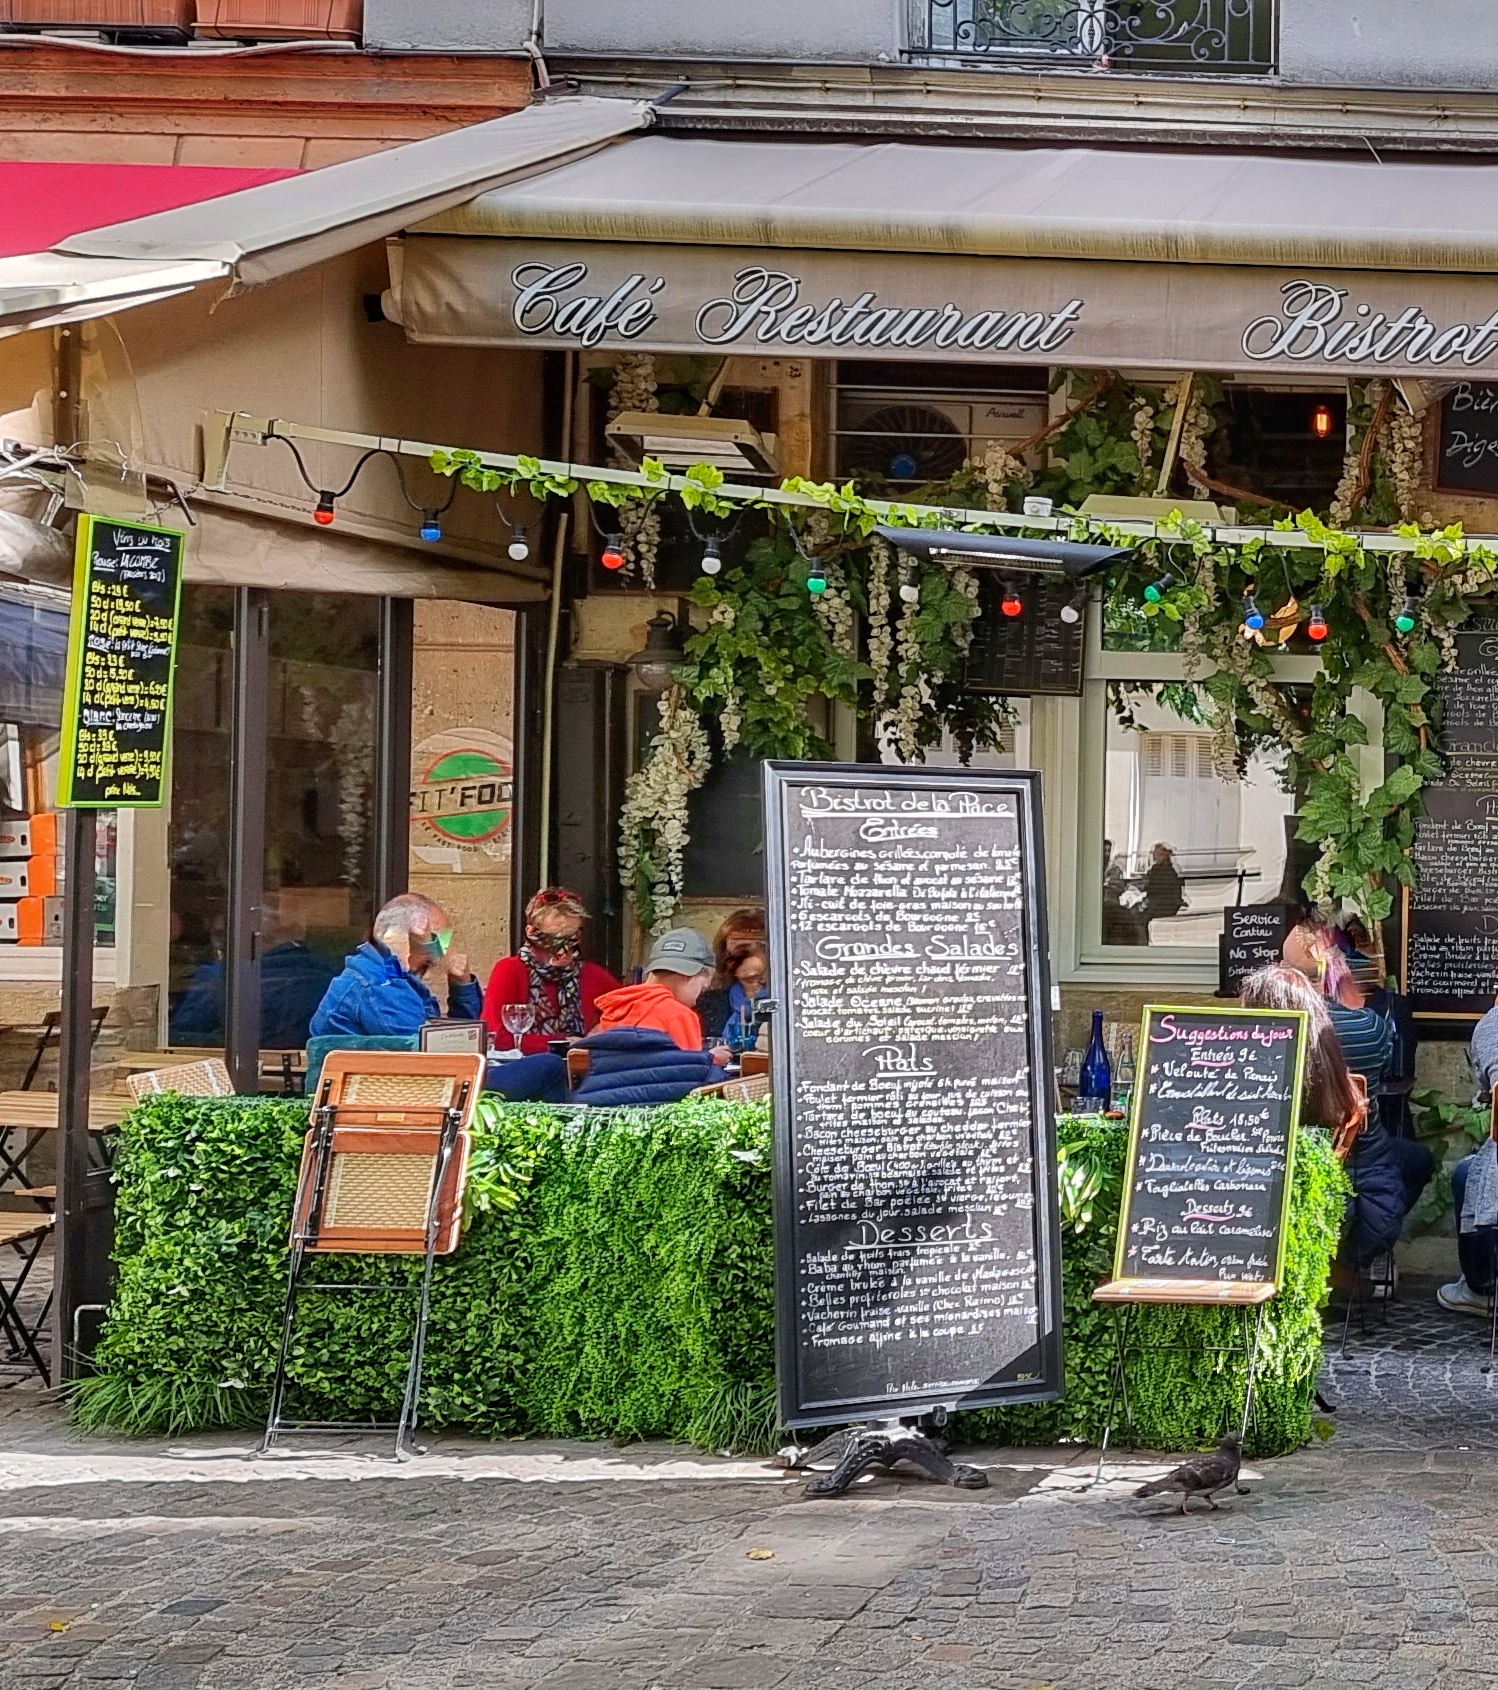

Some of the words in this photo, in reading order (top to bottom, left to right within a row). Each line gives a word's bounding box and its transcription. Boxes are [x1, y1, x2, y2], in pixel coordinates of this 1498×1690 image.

[511, 261, 665, 348] Café
[695, 266, 1083, 353] Restaurant
[799, 787, 896, 812] Bistrot
[1232, 913, 1280, 925] Service
[816, 934, 914, 959] Grandes
[925, 934, 1018, 956] Salades
[1229, 947, 1246, 959] No
[800, 961, 845, 976] Salade
[1150, 1015, 1248, 1045] Suggestions
[849, 1213, 993, 1247] Desserts
